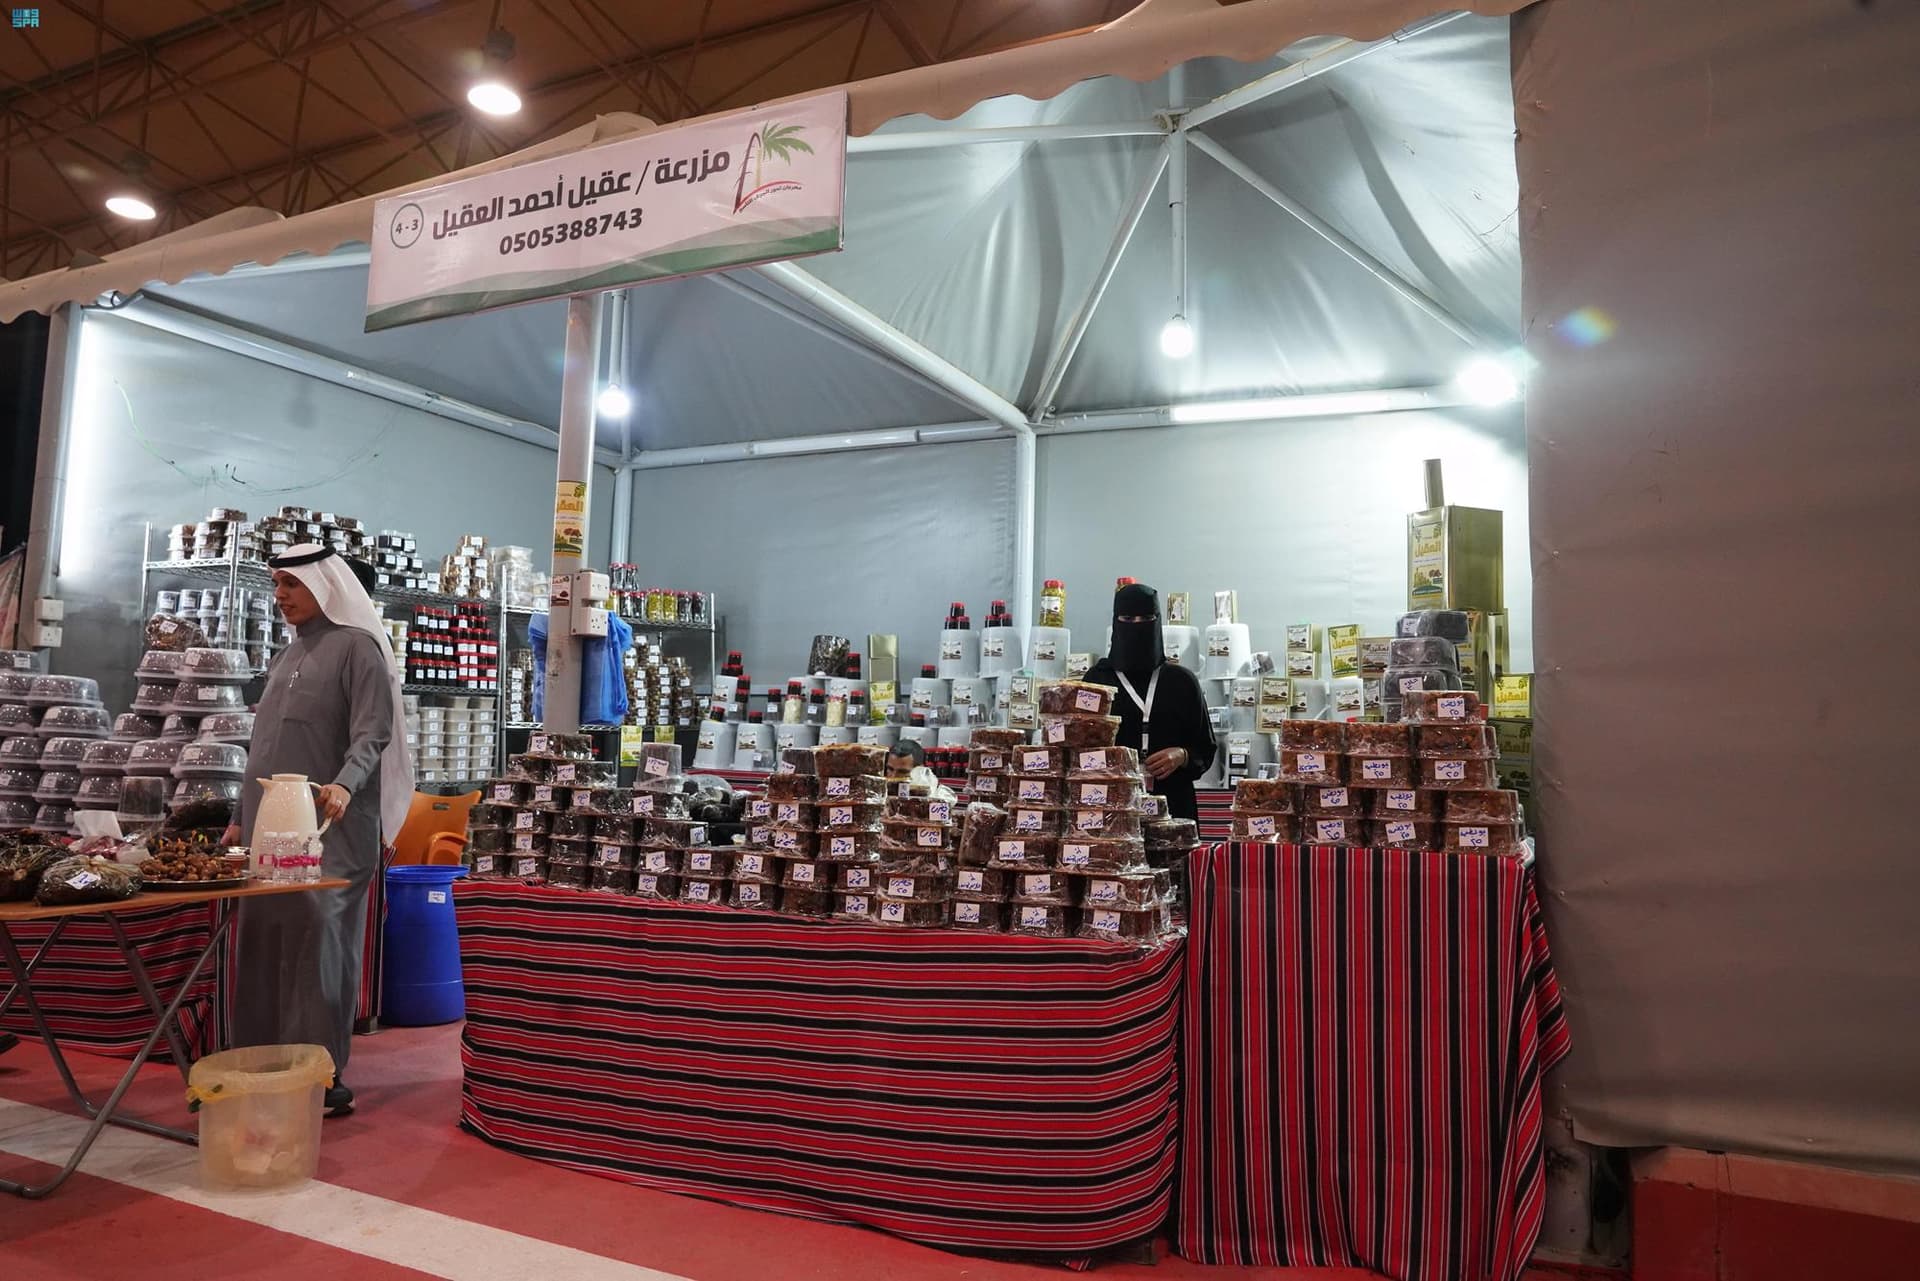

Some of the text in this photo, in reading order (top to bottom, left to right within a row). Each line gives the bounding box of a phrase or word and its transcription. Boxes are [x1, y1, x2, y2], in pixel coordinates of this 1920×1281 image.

[432, 149, 730, 240] مزرعة / عقيل أحمد العقيل
[499, 208, 643, 255] 0505388743
